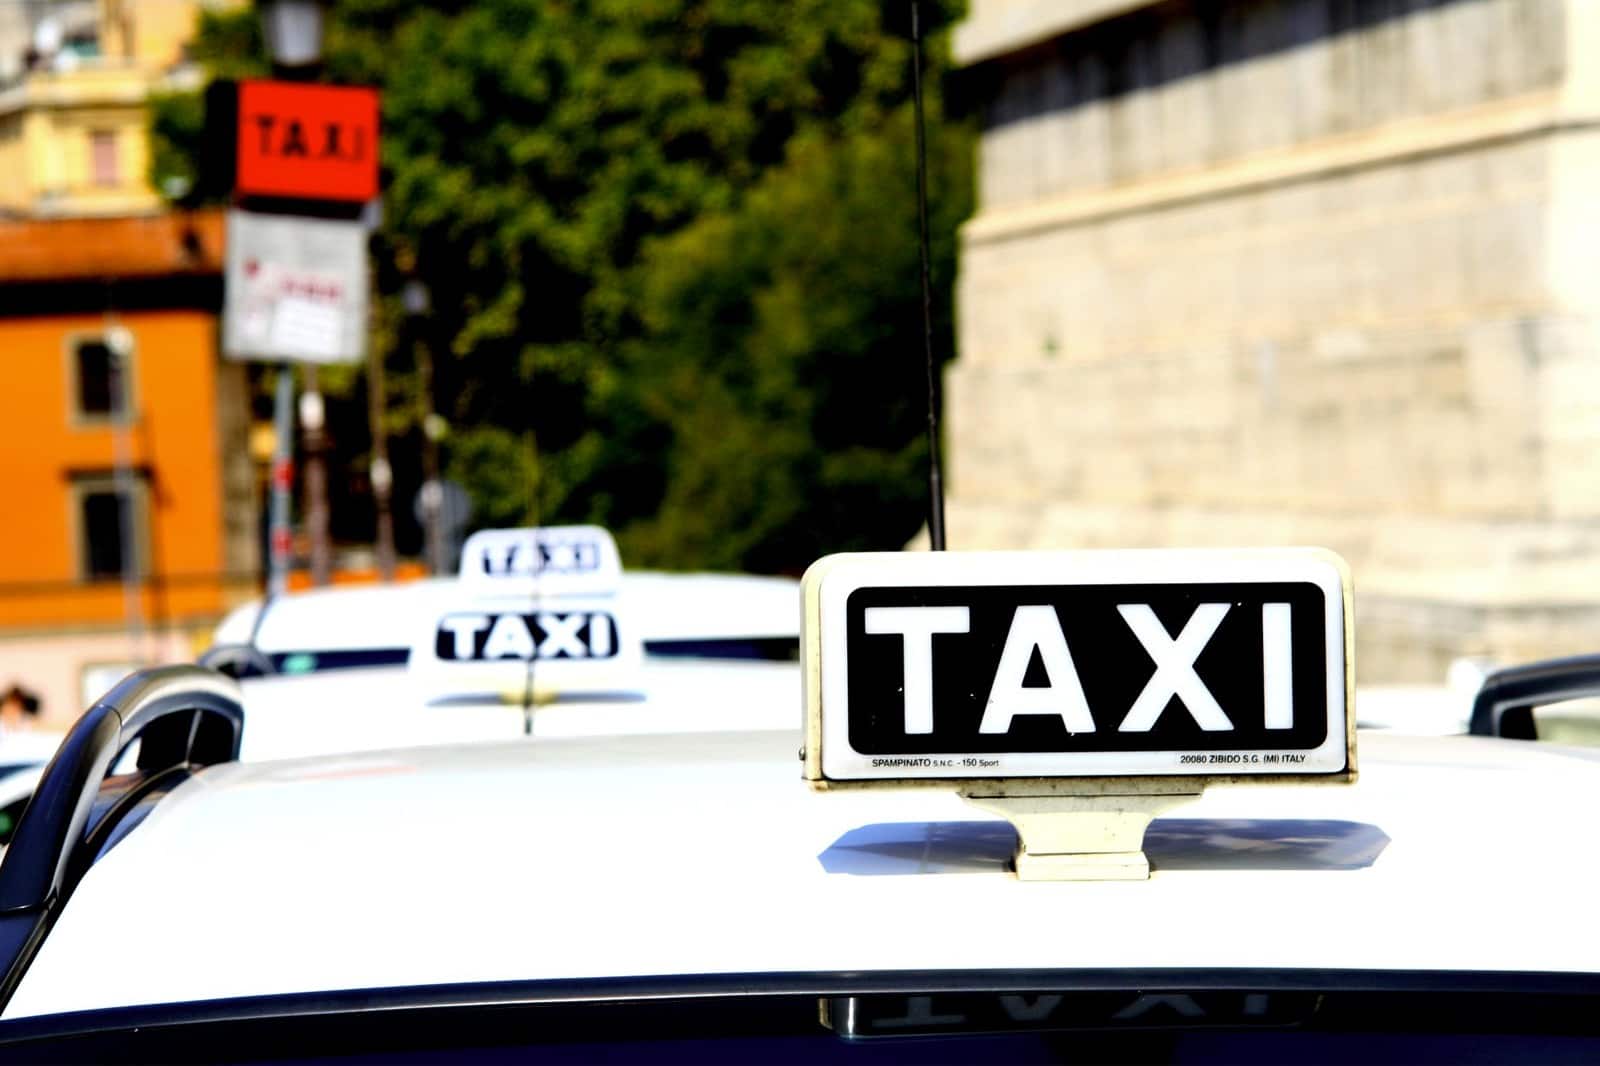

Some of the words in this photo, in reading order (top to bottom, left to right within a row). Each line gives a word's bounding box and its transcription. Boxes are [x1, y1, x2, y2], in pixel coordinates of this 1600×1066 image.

[255, 113, 366, 161] TAXI
[439, 613, 612, 660] TAXI
[865, 603, 1293, 735] TAXI
[872, 758, 931, 767] SPAMPINATO
[979, 759, 999, 768] Sport
[1180, 754, 1207, 764] 20080
[1208, 754, 1240, 764] ZIBIDO
[1263, 753, 1279, 764] (MI)
[1281, 754, 1305, 763] ITALY
